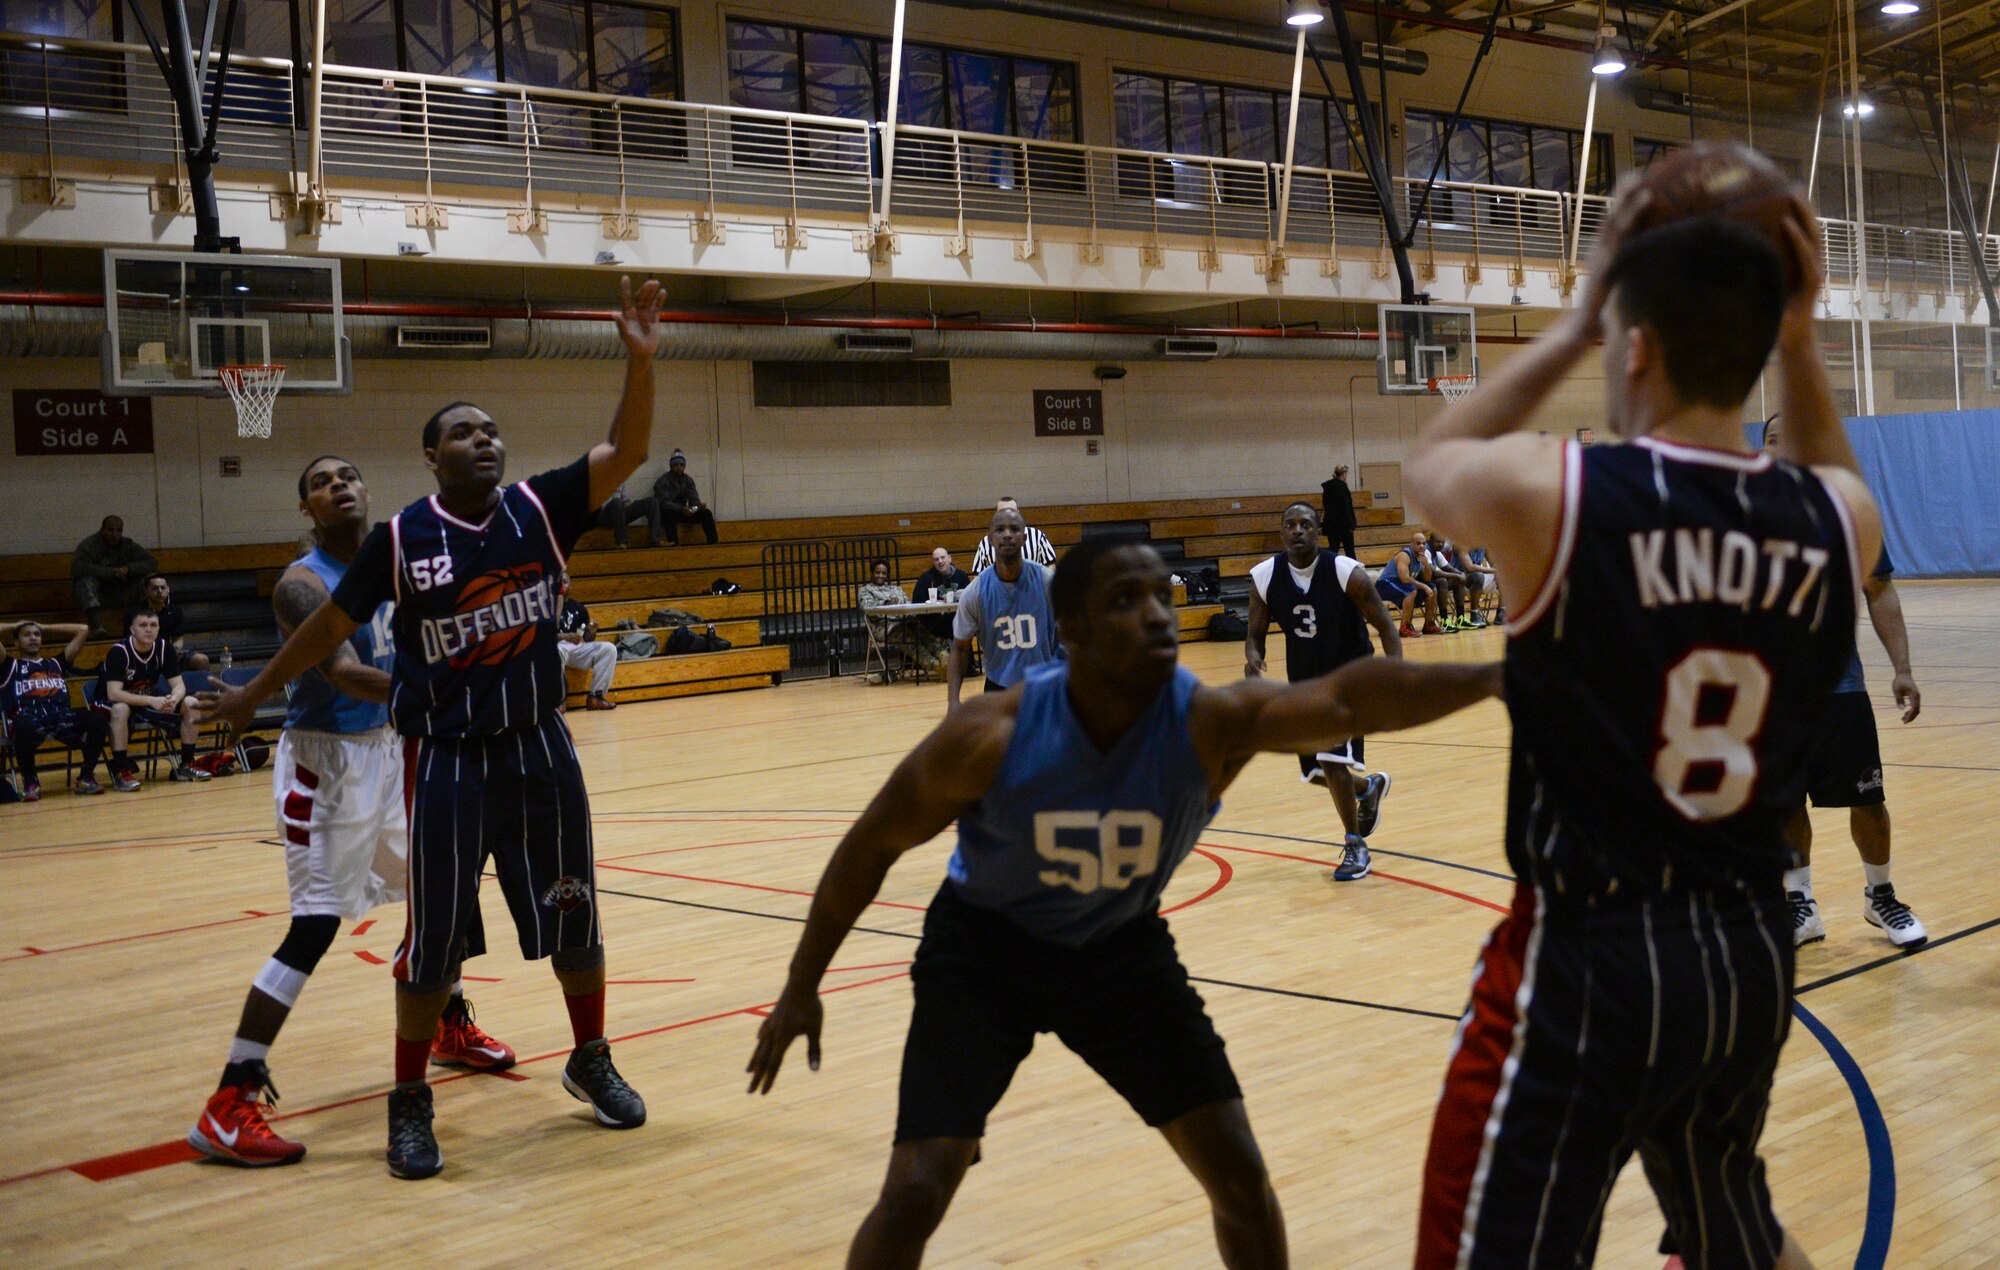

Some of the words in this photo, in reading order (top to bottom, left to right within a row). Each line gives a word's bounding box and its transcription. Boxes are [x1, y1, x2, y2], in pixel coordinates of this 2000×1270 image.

[35, 397, 107, 417] Court
[119, 398, 130, 416] 1
[1044, 396, 1081, 409] Court
[1086, 396, 1092, 409] 1
[41, 427, 99, 447] Side
[112, 427, 129, 446] A
[1047, 417, 1077, 431] Side
[1082, 417, 1092, 430] B
[410, 554, 454, 592] 52
[993, 614, 1037, 650] 30
[1292, 604, 1317, 639] 3
[1650, 644, 1773, 824] 8
[1033, 808, 1163, 895] 58
